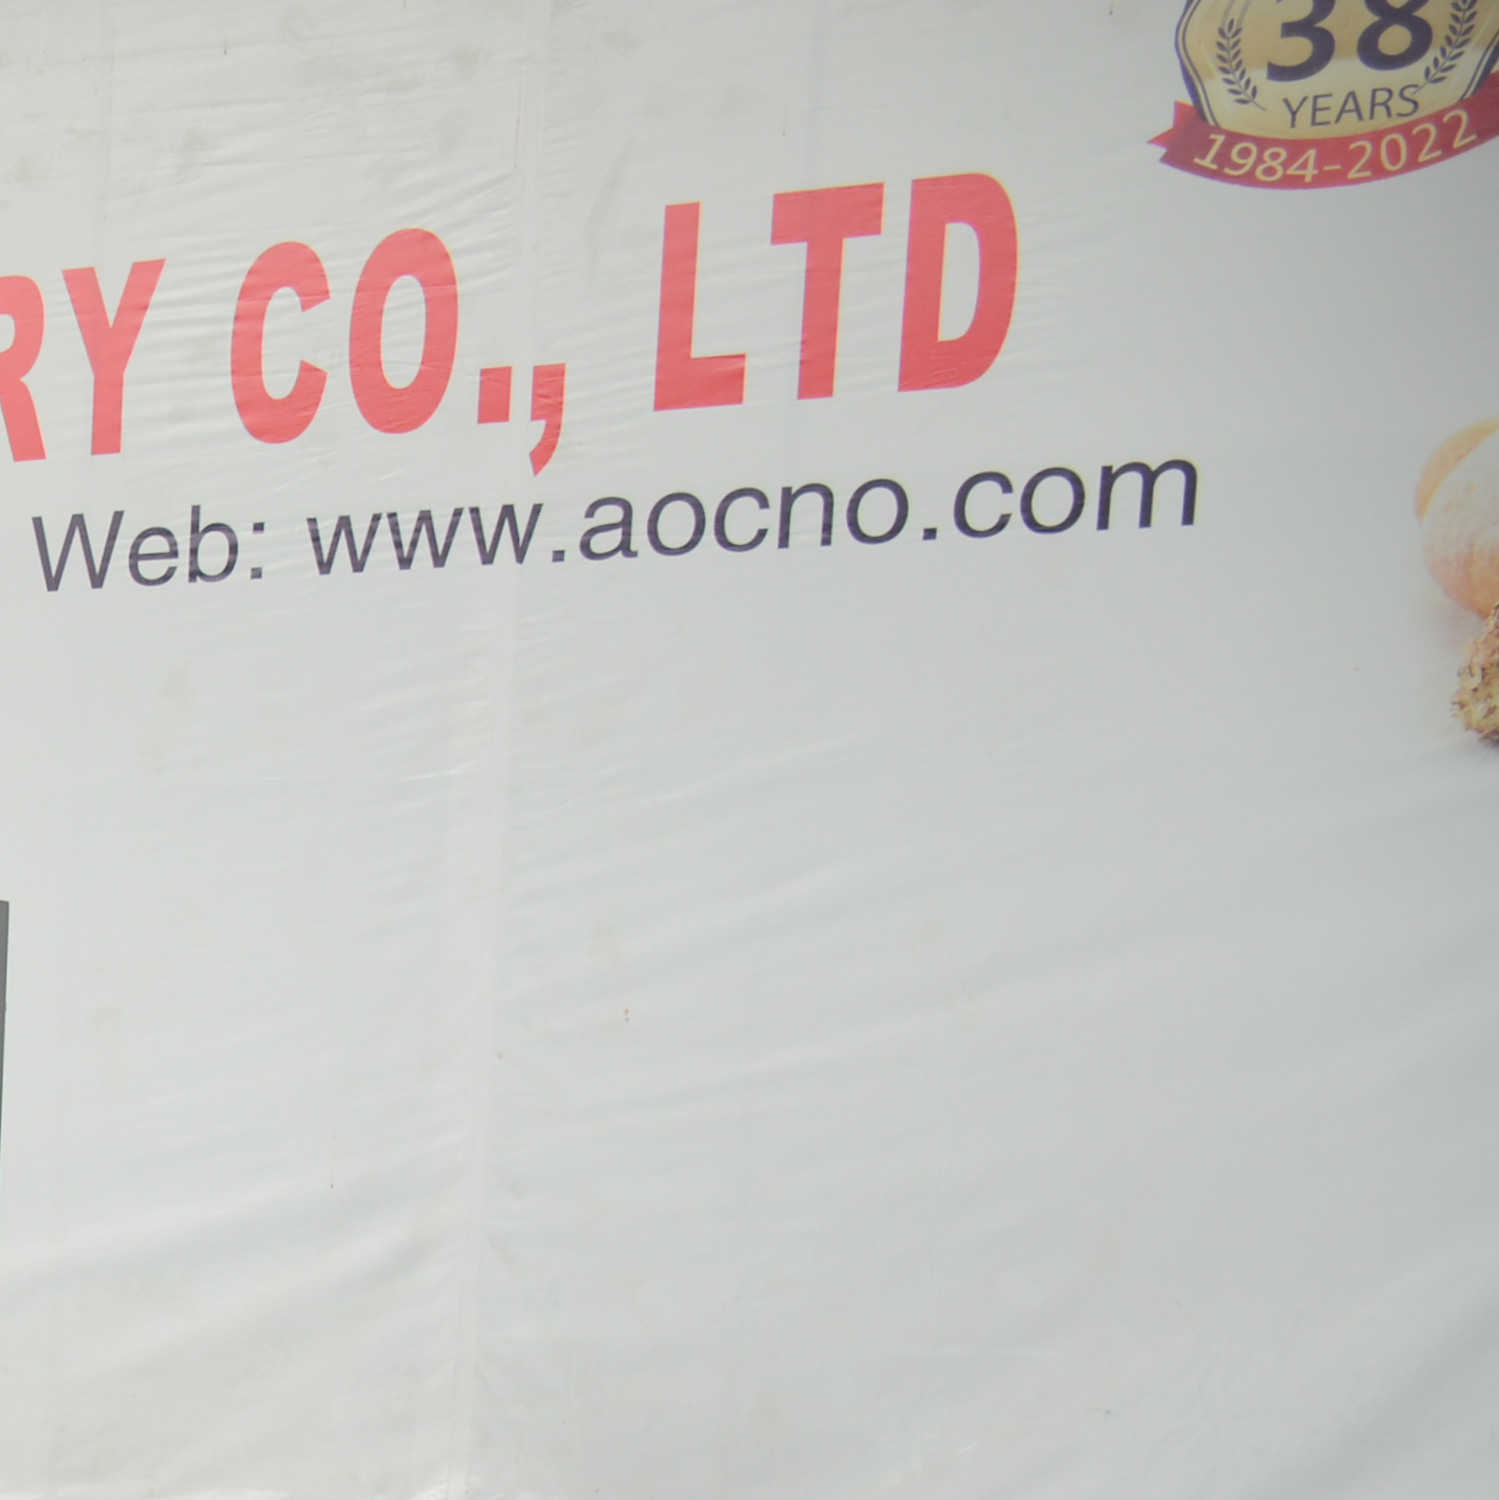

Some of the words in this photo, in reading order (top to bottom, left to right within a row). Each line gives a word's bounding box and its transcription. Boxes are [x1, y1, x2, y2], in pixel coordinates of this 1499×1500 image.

[1266, 0, 1433, 82] 38
[1193, 109, 1477, 183] 1984-2022
[1282, 84, 1419, 129] YEARS
[230, 227, 567, 476] CO.,
[653, 172, 1020, 412] LTD
[30, 503, 267, 593] Web:
[305, 457, 1200, 576] www.aocno.com
